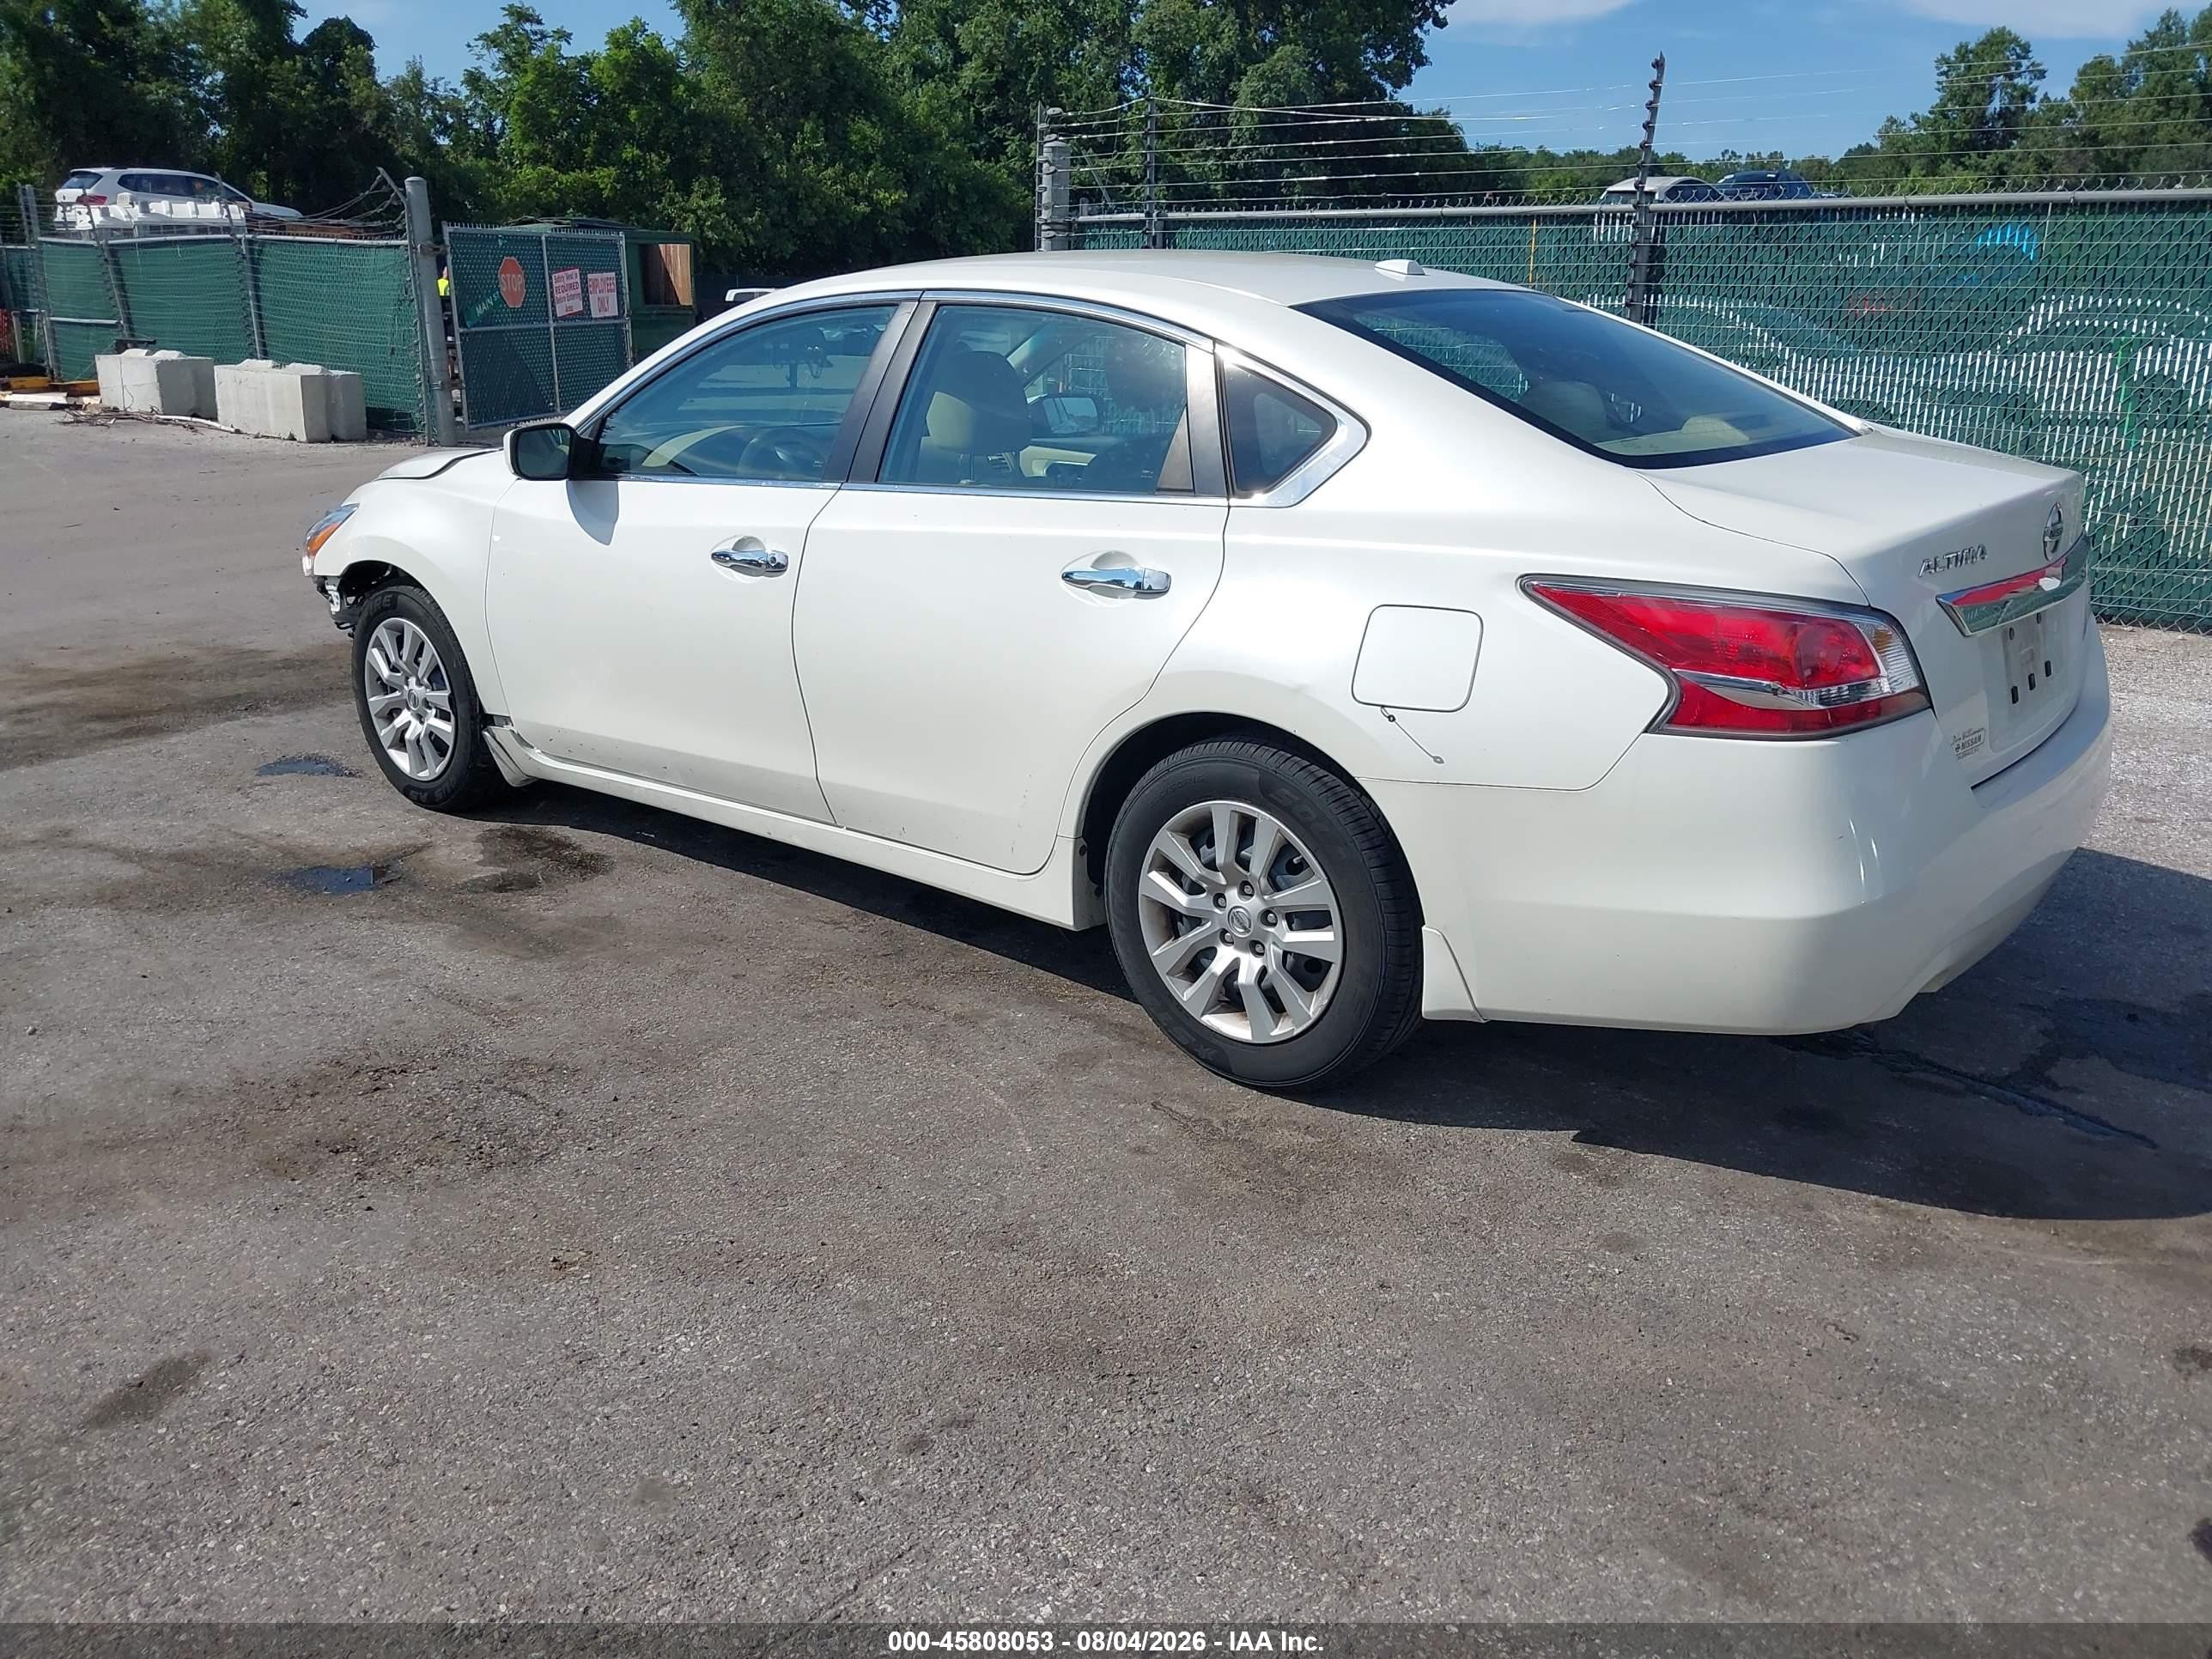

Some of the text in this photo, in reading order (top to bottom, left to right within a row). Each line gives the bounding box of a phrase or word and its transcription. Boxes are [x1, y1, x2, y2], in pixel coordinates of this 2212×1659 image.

[501, 274, 523, 291] STOP
[555, 281, 580, 295] REQUIRED
[588, 276, 616, 295] EMPLOYEES
[476, 295, 494, 317] MAIN
[598, 296, 610, 313] ONLY
[1917, 543, 1989, 578] ALTIMA
[1960, 734, 1982, 751] NISSAN
